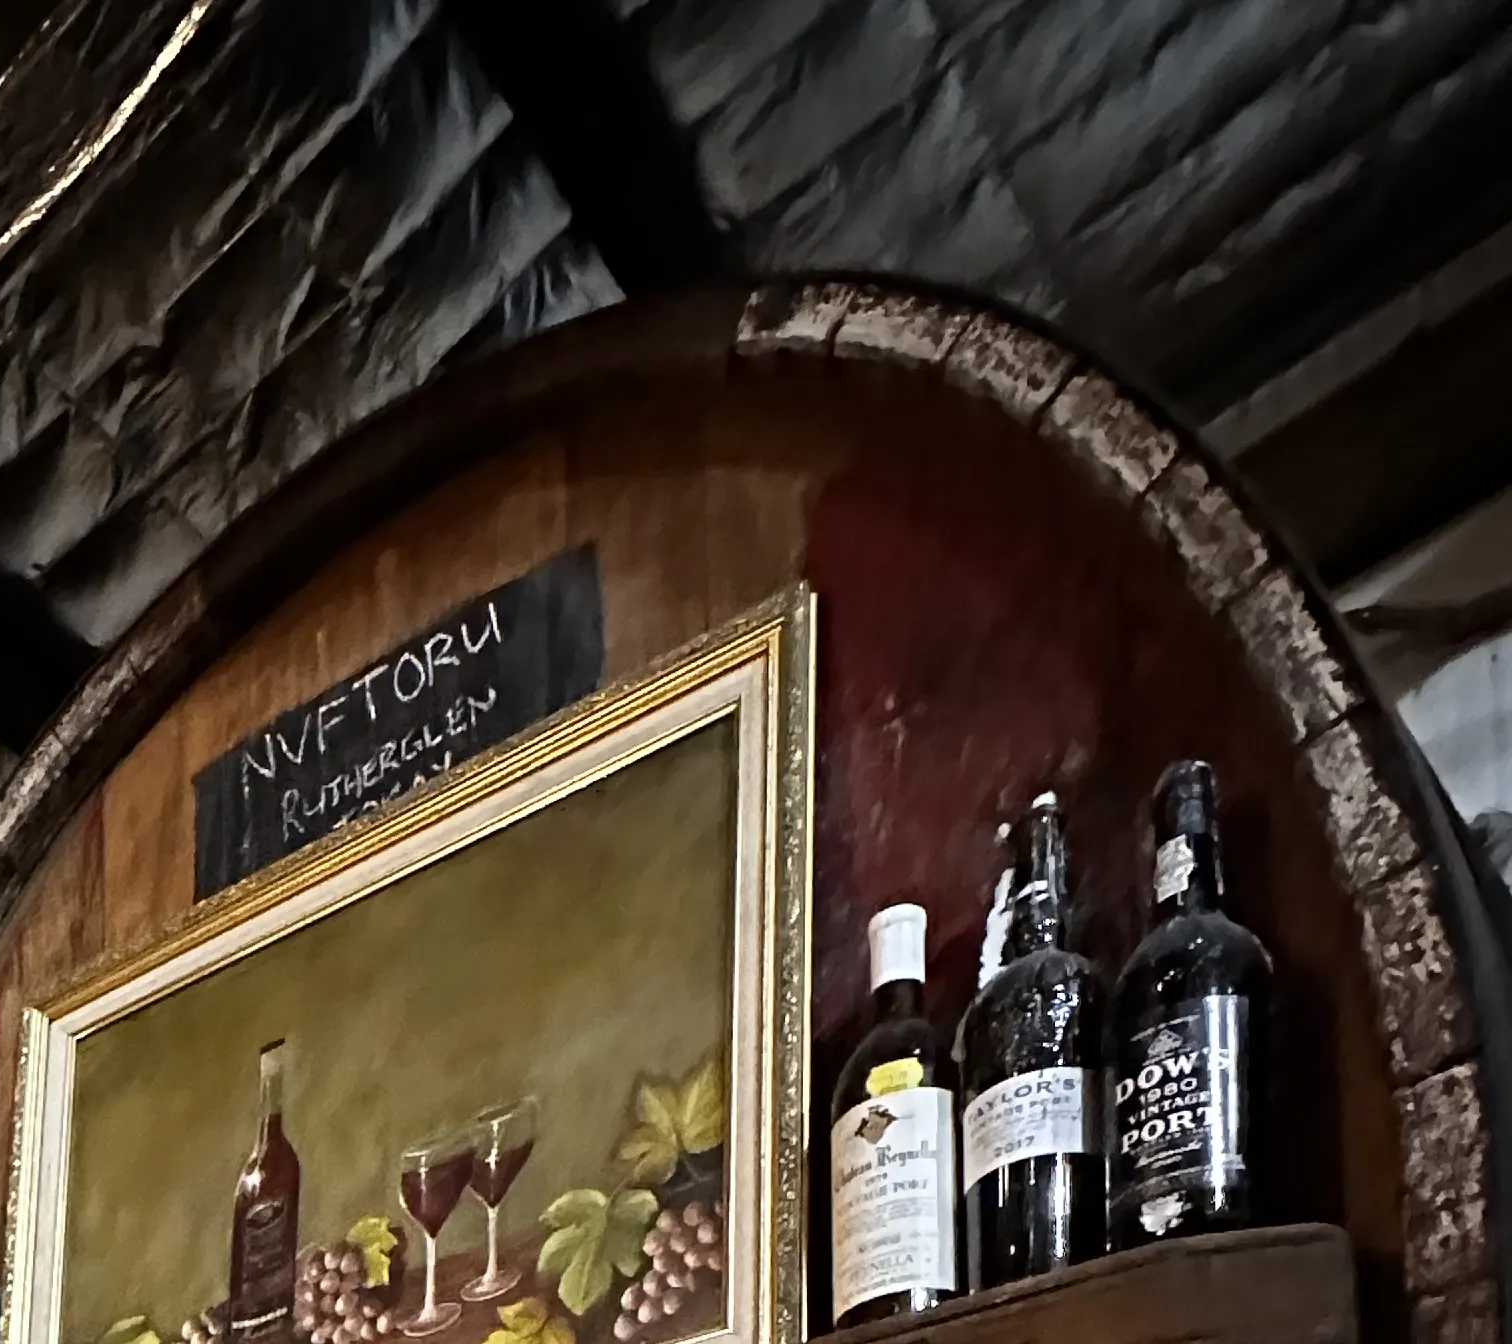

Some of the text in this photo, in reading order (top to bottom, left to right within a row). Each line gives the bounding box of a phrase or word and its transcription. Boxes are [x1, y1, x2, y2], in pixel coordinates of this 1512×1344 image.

[281, 685, 497, 842] RUTHERGLEN
[1128, 1089, 1212, 1125] VINTAGE
[1138, 1076, 1198, 1104] 1980
[994, 1134, 1035, 1157] 2017
[1121, 1106, 1219, 1154] PORT
